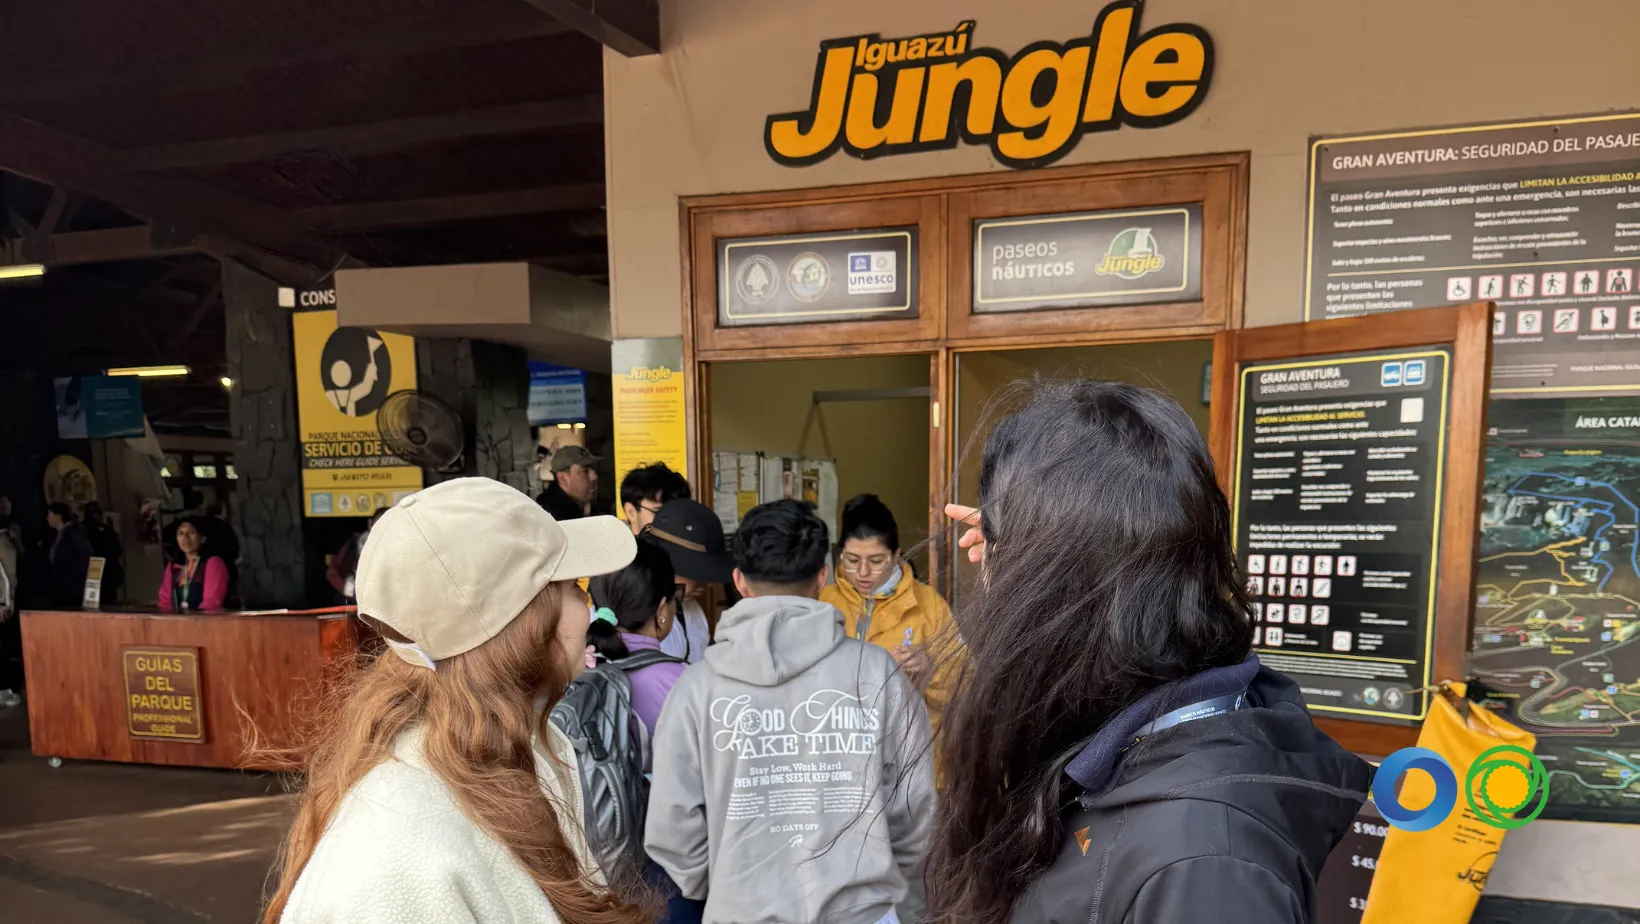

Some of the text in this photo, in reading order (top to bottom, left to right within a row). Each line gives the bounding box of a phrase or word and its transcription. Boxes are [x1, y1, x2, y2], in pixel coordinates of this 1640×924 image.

[855, 24, 969, 71] Iguazú
[769, 5, 1206, 161] Jungle
[1332, 154, 1373, 170] GRAN
[1376, 148, 1459, 167] AVENTURA:
[1462, 140, 1549, 160] SEGURIDAD
[1553, 138, 1582, 152] DEL
[1330, 193, 1338, 202] El
[1340, 194, 1363, 202] paseo
[1364, 190, 1384, 199] Gran
[1385, 188, 1420, 198] Aventura
[1422, 185, 1457, 197] presenta
[1458, 182, 1501, 194] exigencias
[1502, 182, 1518, 191] que
[1520, 178, 1554, 188] LIMITAN
[1556, 176, 1567, 186] LA
[1568, 172, 1634, 185] ACCESIBILIDAD
[1330, 204, 1352, 214] Tanto
[1365, 200, 1412, 212] condiciones
[1413, 197, 1450, 208] normales
[1452, 197, 1474, 206] como
[1476, 194, 1494, 204] ante
[1513, 190, 1564, 202] emergencia,
[1565, 190, 1580, 198] son
[1582, 186, 1626, 196] necesarias
[992, 240, 1058, 264] paseos
[1096, 254, 1163, 274] Jungle
[850, 275, 894, 285] unesco
[1326, 282, 1341, 291] Por
[1342, 282, 1350, 290] lo
[1374, 280, 1386, 289] las
[1387, 279, 1424, 289] personas
[1365, 300, 1414, 310] limitaciones
[1260, 367, 1340, 384] GRAN AVENTURA
[1260, 379, 1349, 394] SEGURIDAD DEL PASAJERO
[1575, 415, 1606, 428] ÁREA
[308, 432, 338, 440] PARQUE
[304, 442, 361, 457] SERVICIO
[364, 441, 381, 455] DE
[309, 459, 334, 467] CHECK
[356, 458, 379, 466] GUIDE
[136, 656, 182, 672] GUÍAS
[145, 676, 174, 691] DEL
[131, 694, 193, 710] PARQUE
[133, 713, 192, 724] PROFESSIONAL
[152, 724, 176, 734] GUIDE
[805, 732, 877, 754] TIME
[750, 761, 842, 776] Stay Low, Work Hard
[734, 778, 752, 788] EVEN
[752, 776, 759, 786] IF
[760, 776, 769, 785] NO
[771, 774, 784, 784] ONE
[785, 773, 803, 783] SEES
[812, 772, 830, 782] KEEP
[831, 771, 852, 782] GOING
